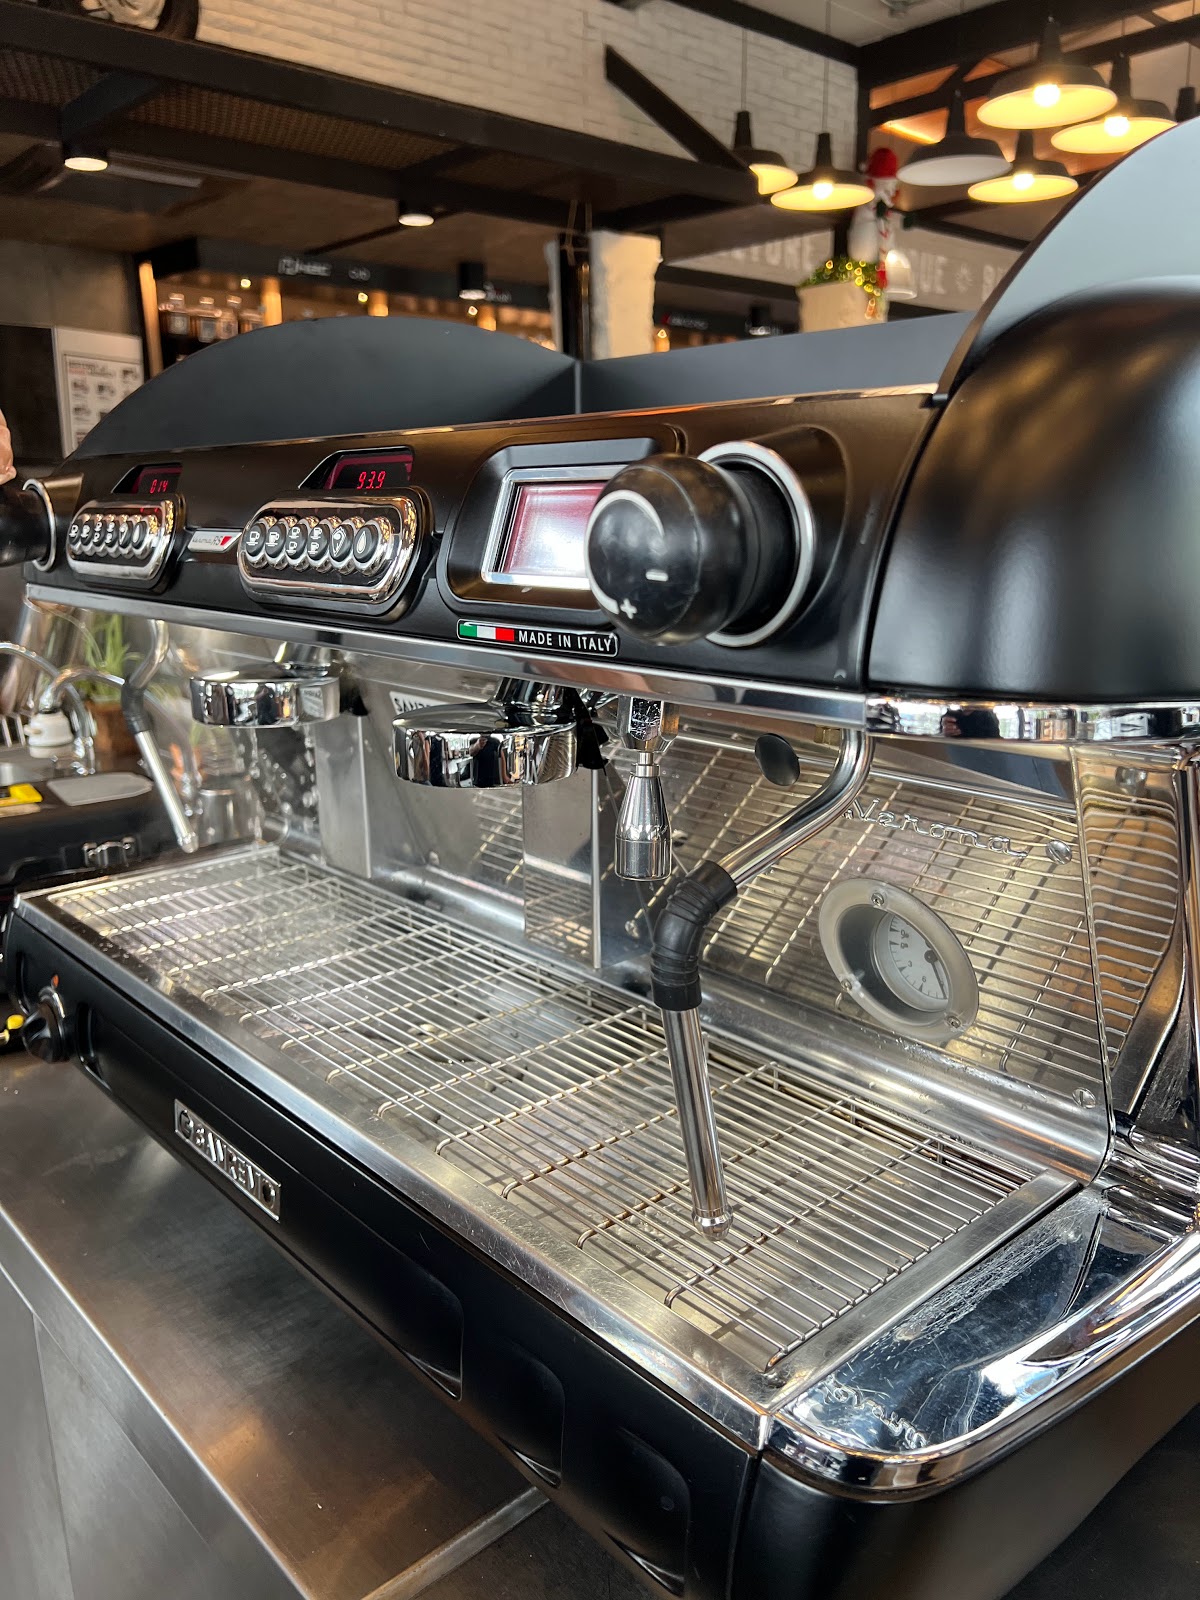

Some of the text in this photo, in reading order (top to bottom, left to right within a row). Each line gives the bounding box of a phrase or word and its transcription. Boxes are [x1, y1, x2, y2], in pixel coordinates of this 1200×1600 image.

[357, 470, 386, 489] 93.9
[518, 630, 611, 652] MADE IN ITALY
[841, 798, 1028, 858] Verona
